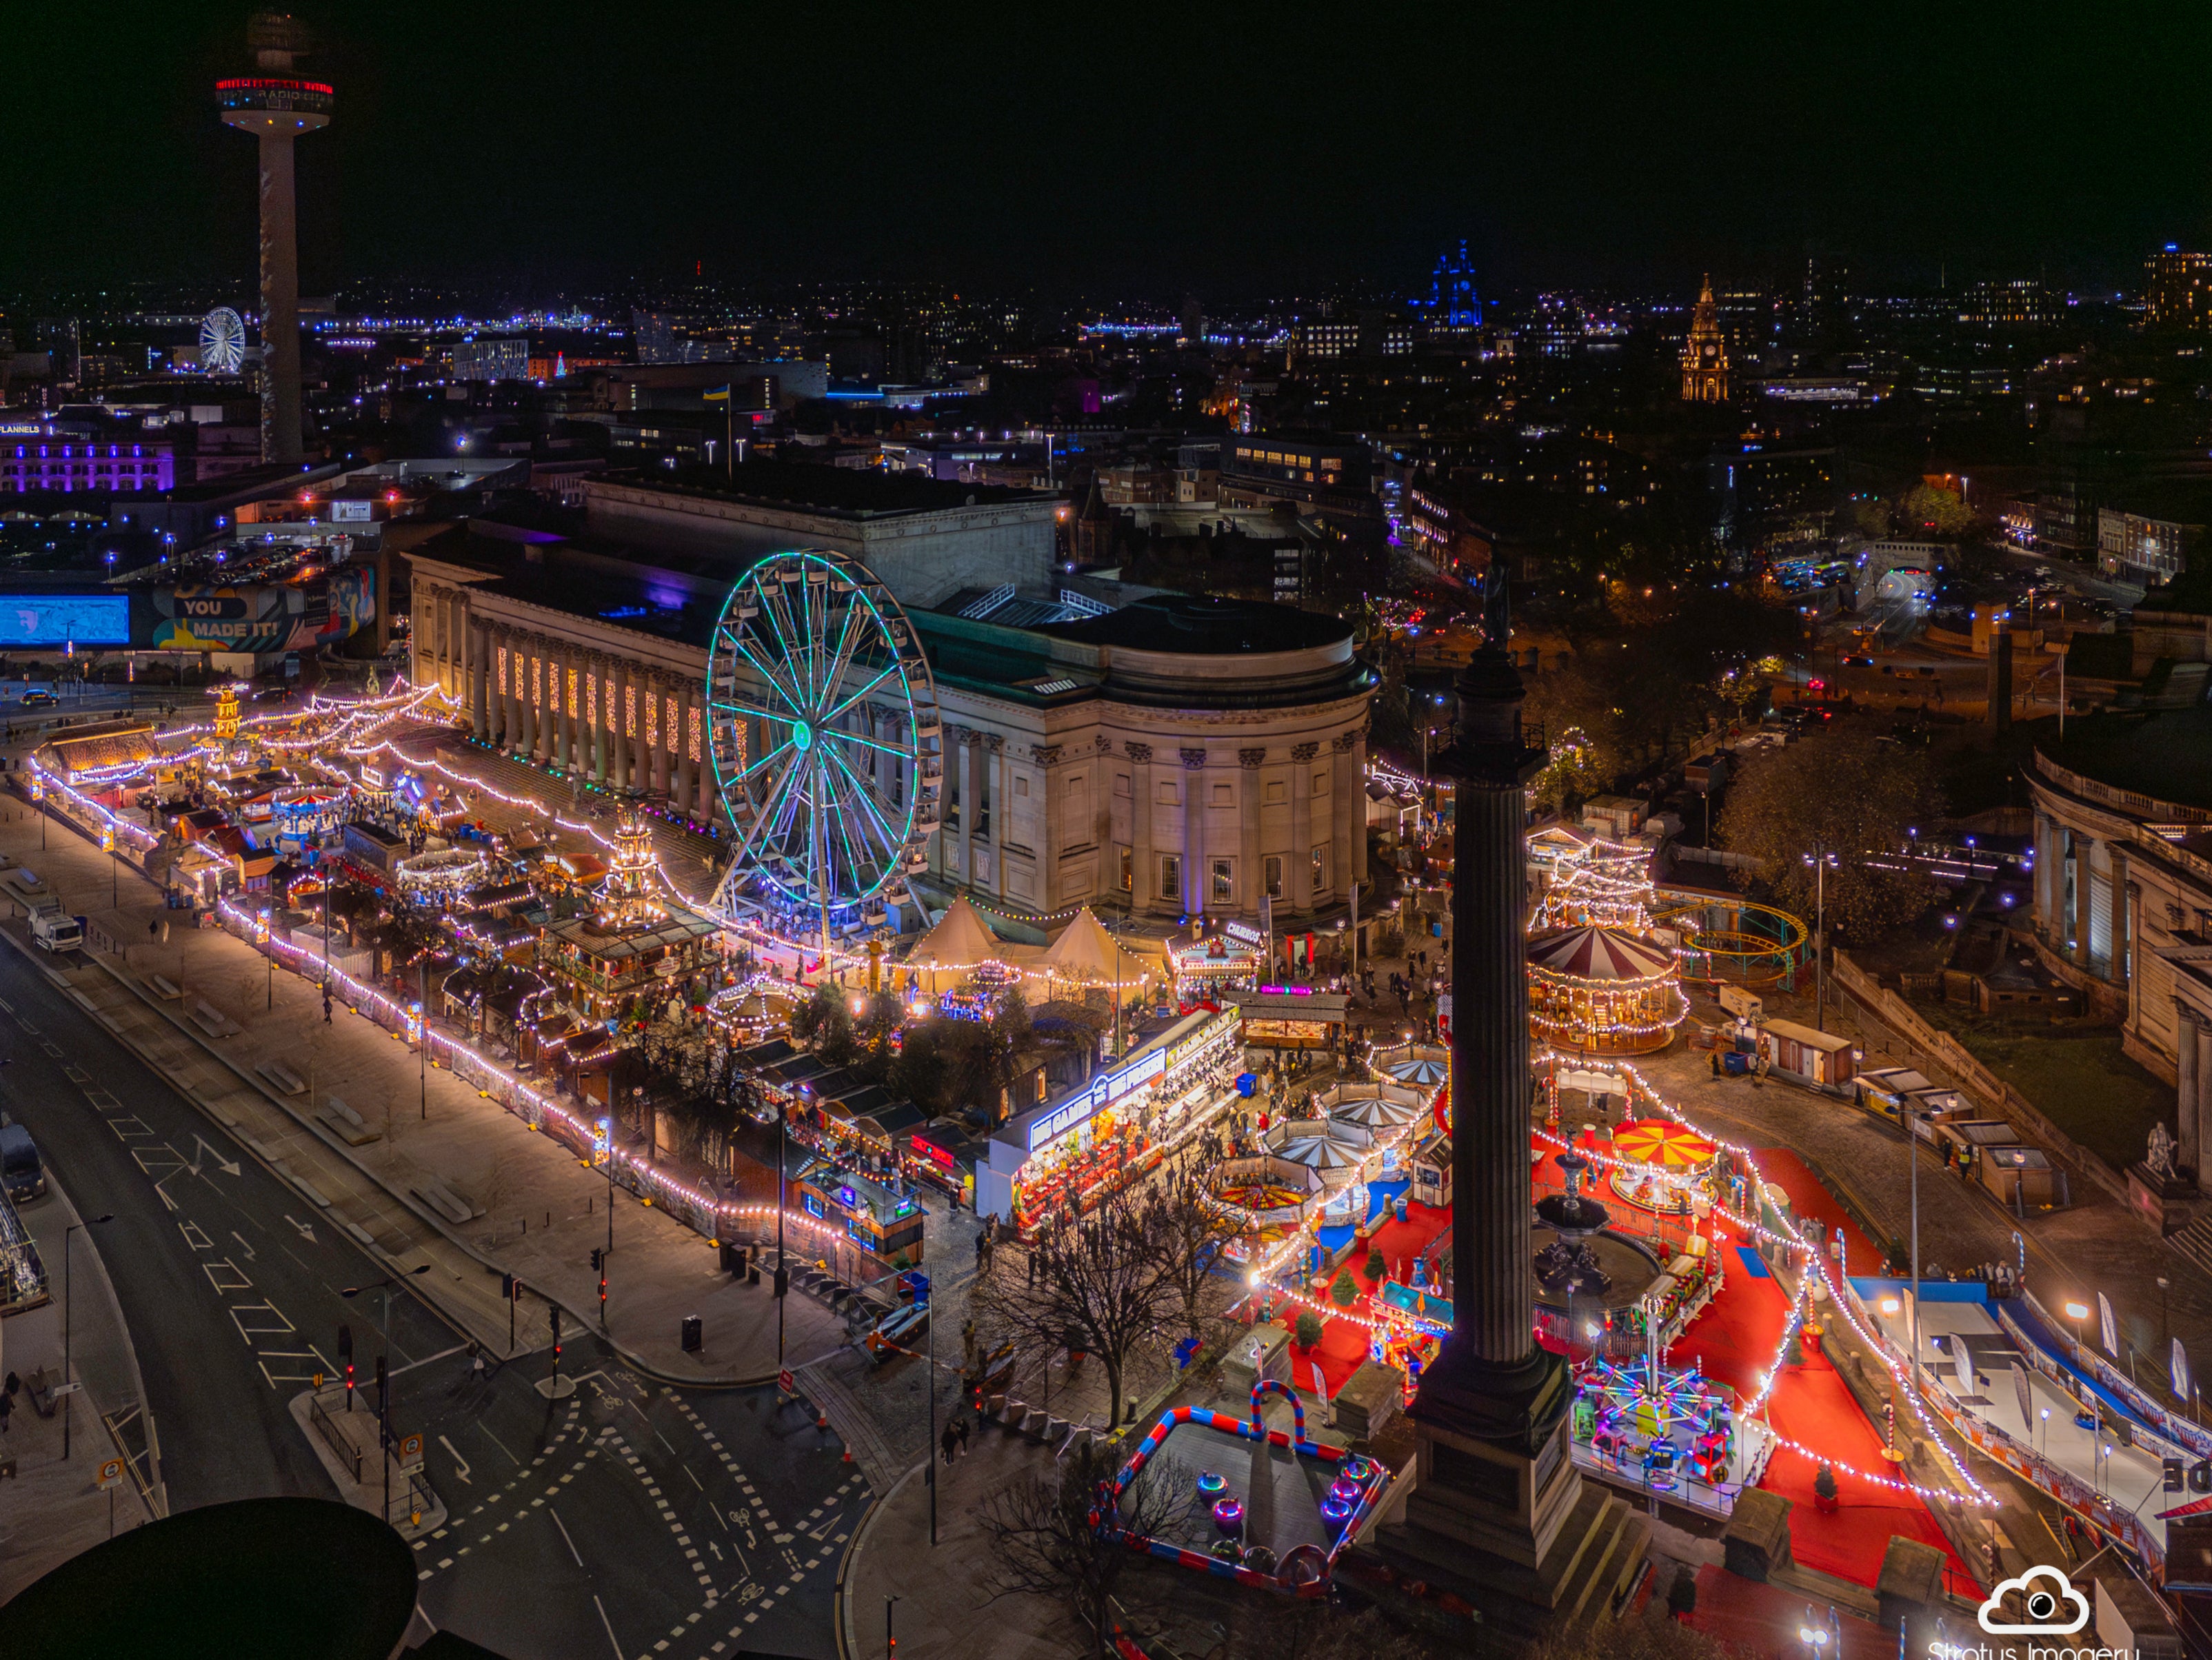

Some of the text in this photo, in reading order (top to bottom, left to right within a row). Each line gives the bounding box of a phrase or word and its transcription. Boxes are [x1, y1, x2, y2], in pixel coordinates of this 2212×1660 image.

[258, 90, 300, 100] RADIO
[184, 600, 222, 616] YOU
[194, 622, 278, 638] MADE IT!
[1226, 922, 1261, 944] CHURROS
